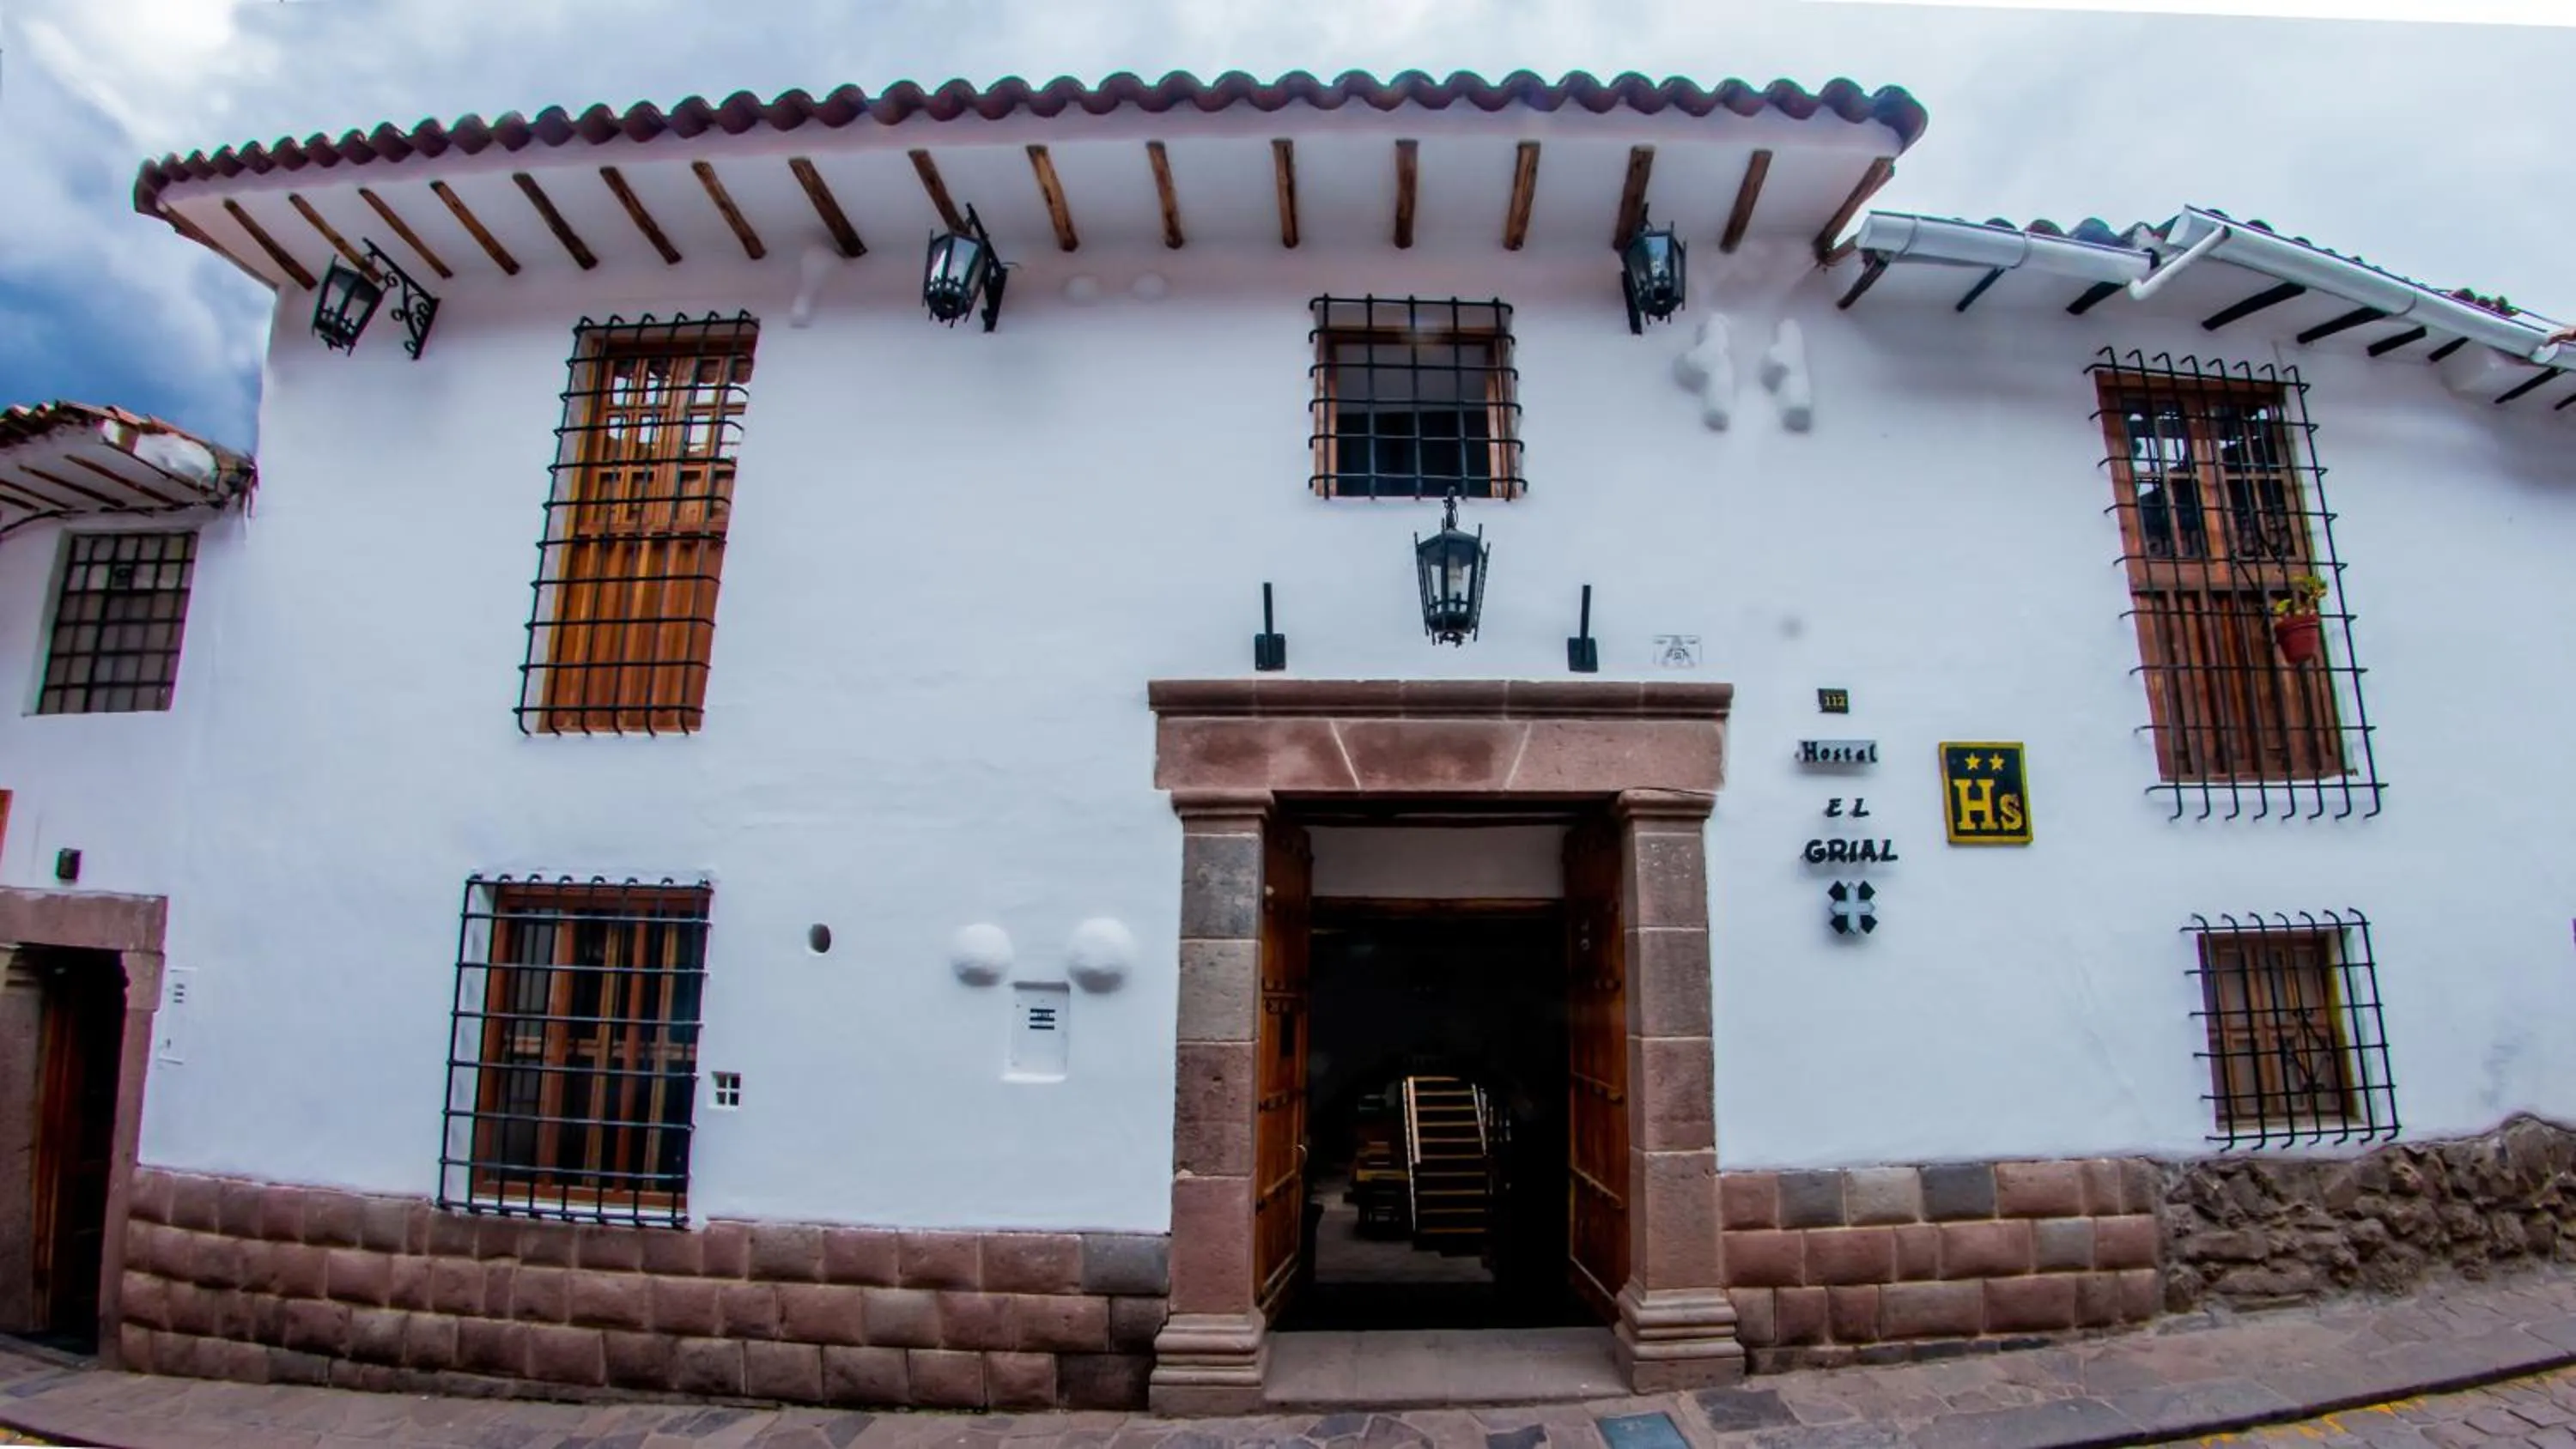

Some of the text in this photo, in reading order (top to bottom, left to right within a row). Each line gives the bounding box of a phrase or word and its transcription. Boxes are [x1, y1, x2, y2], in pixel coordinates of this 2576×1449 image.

[1802, 741, 1878, 763] Hostal
[1825, 797, 1869, 817] EL
[1953, 779, 2022, 830] Hs
[1804, 839, 1899, 864] GRIAL
